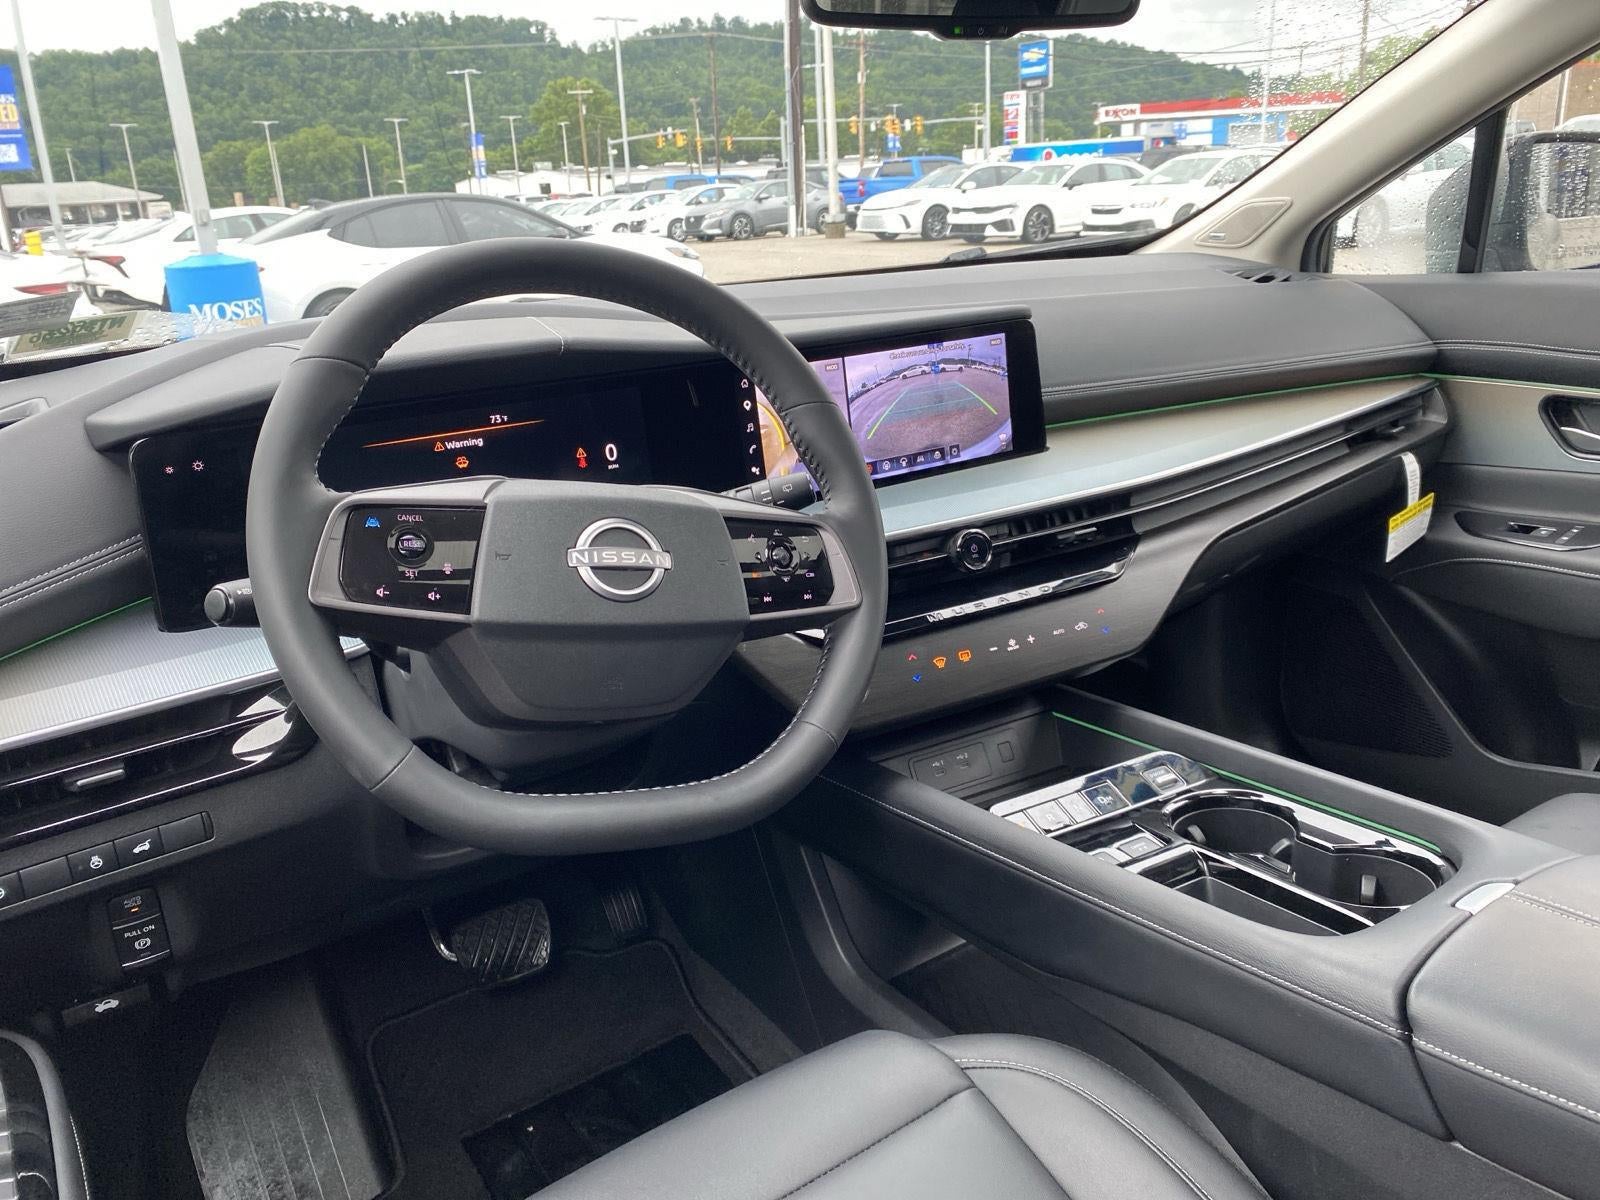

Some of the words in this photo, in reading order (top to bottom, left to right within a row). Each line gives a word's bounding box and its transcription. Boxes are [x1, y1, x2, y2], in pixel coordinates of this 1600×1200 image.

[1104, 108, 1137, 119] EXXON
[188, 298, 263, 321] MOSES
[445, 438, 483, 449] Warning
[605, 443, 617, 461] 0
[397, 514, 424, 522] CANCEL
[571, 550, 670, 567] NISSAN
[405, 569, 418, 577] SET
[927, 585, 1053, 622] MURANO
[124, 929, 141, 938] PULL
